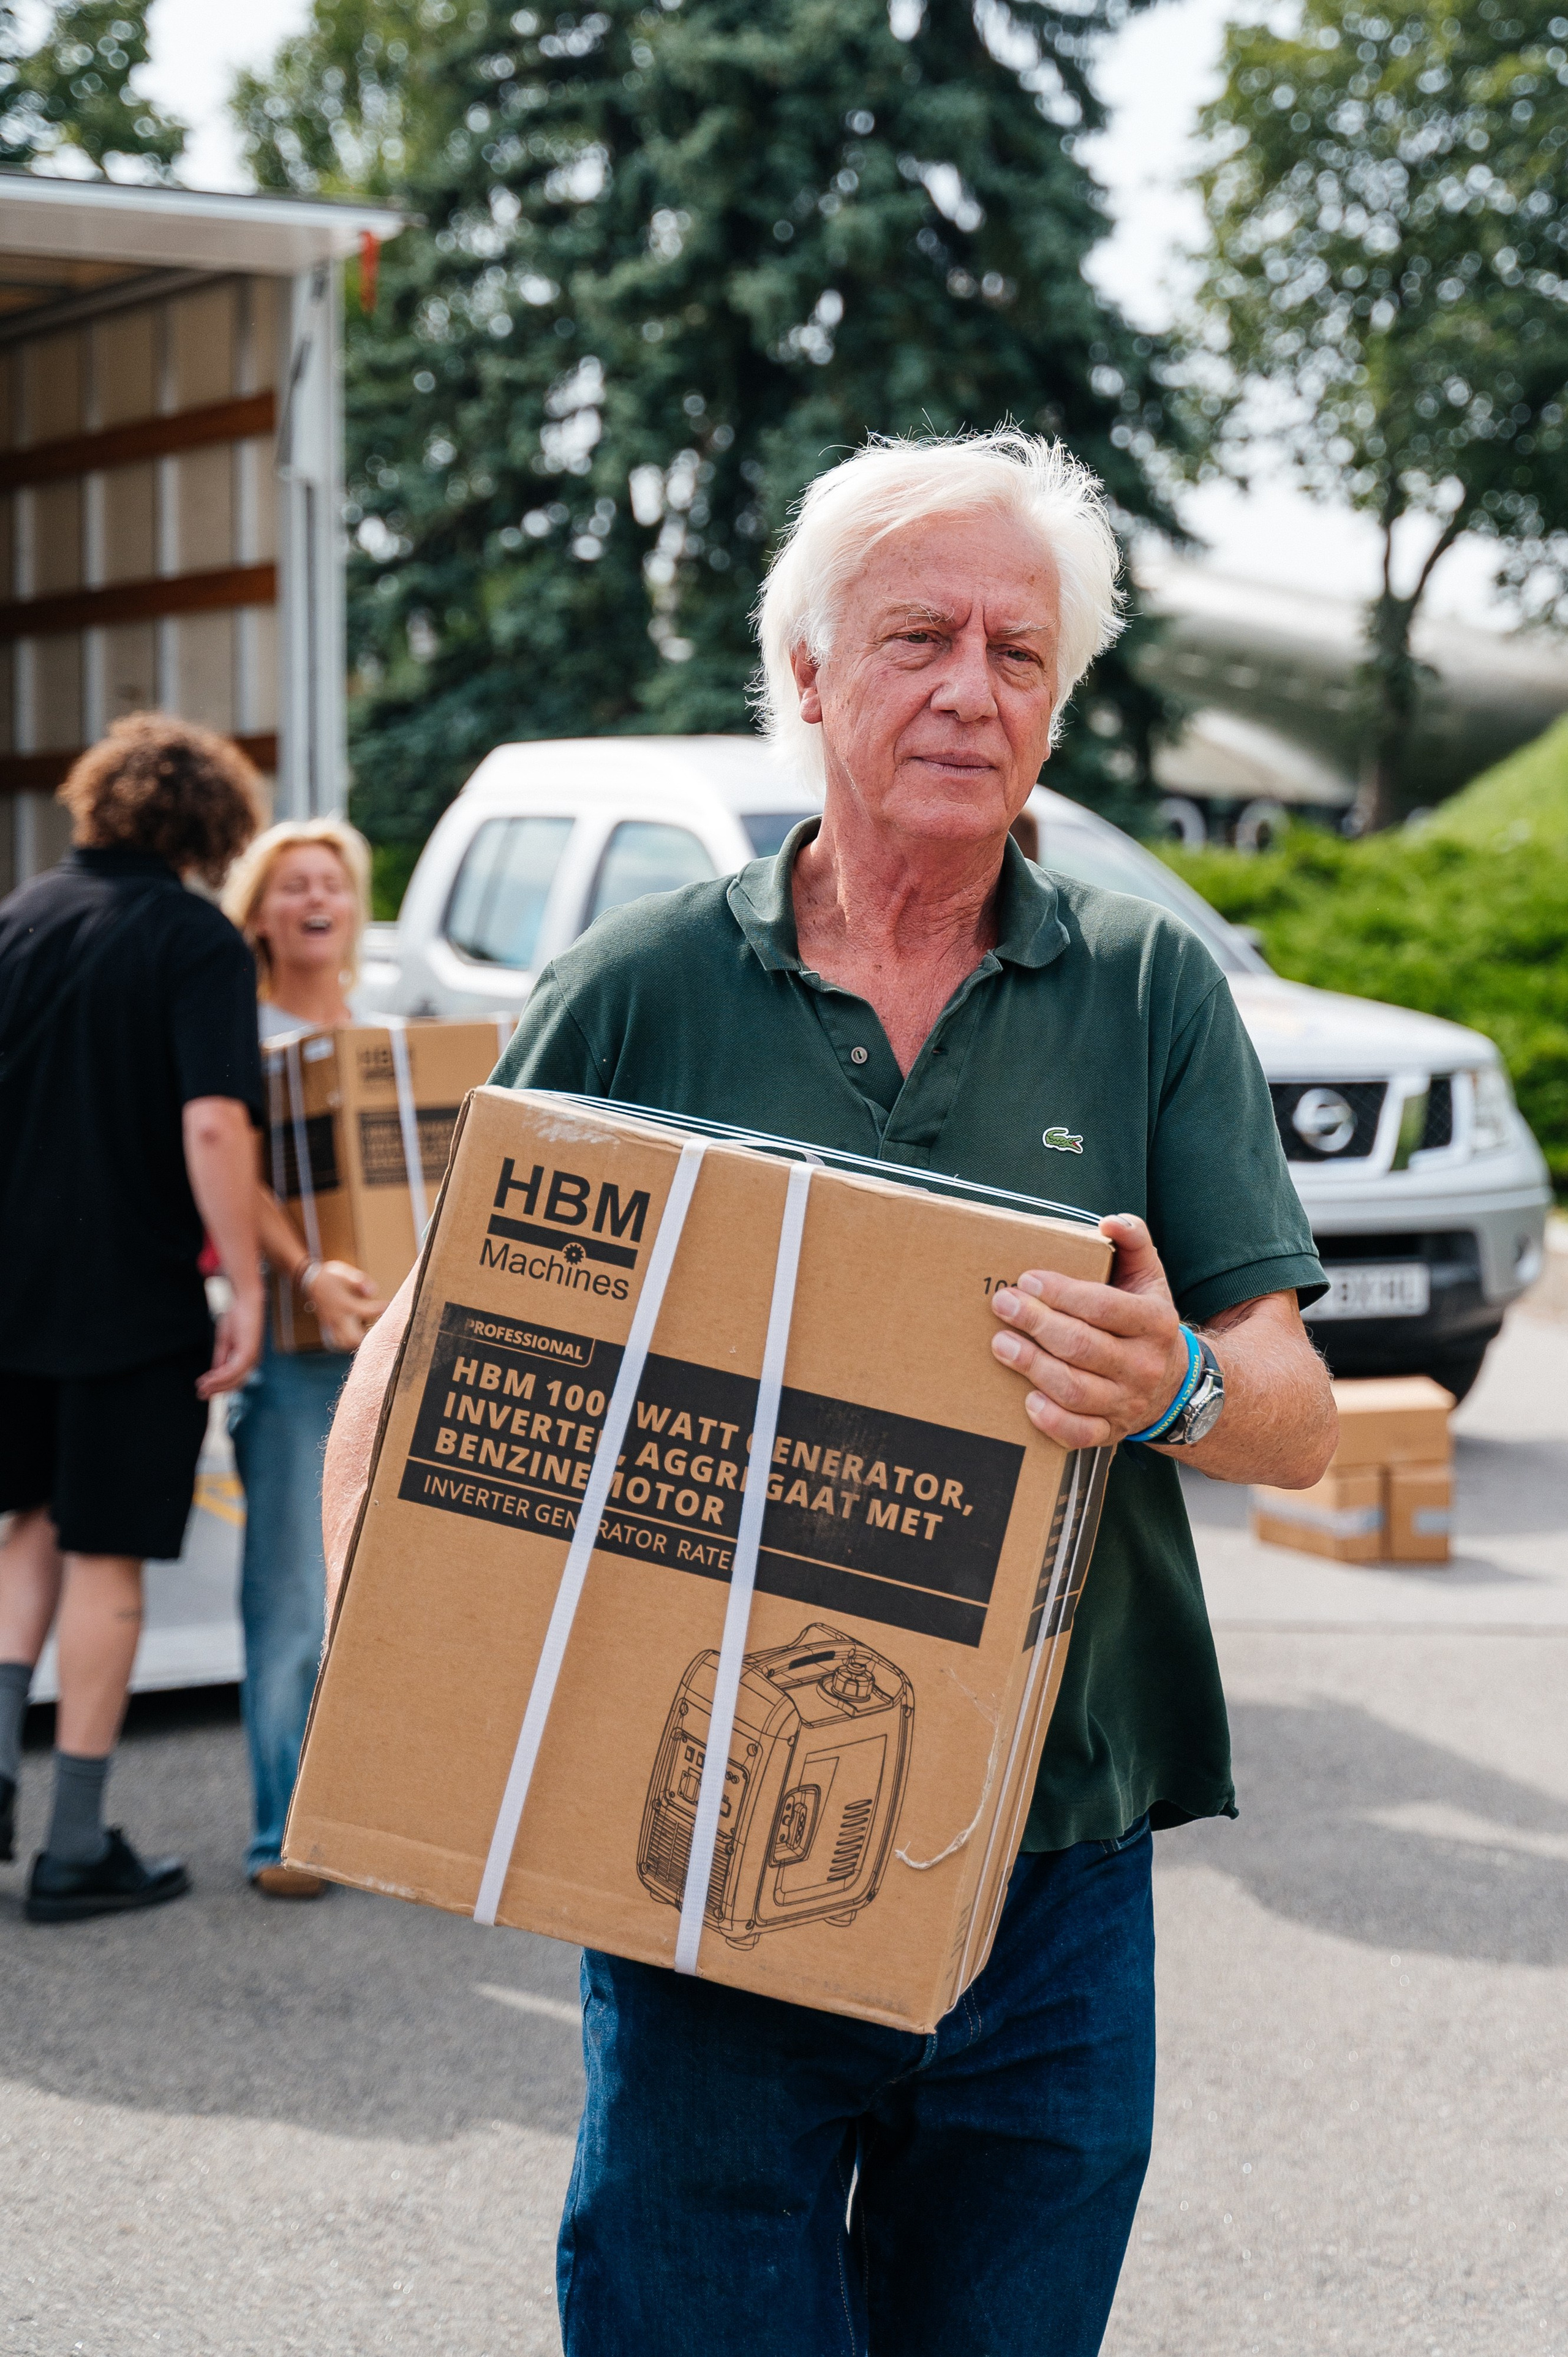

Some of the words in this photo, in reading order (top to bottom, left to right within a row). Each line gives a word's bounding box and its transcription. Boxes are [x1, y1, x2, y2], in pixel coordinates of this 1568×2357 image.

[494, 1157, 650, 1243] HBM
[479, 1238, 629, 1300] Machines
[464, 1318, 583, 1360] PROFESSIONAL
[1182, 1354, 1200, 1403] PROTECT
[452, 1356, 536, 1400] HBM
[546, 1380, 612, 1417] 100
[637, 1401, 739, 1450] WATT
[746, 1433, 973, 1517] ENERATOR,
[1148, 1403, 1184, 1438] UKRAINE
[443, 1391, 626, 1465] INVERTE,
[865, 1498, 943, 1541] MET
[423, 1475, 530, 1518] INVERTER
[535, 1504, 667, 1554] GENRATOR
[677, 1539, 735, 1572] RATE
